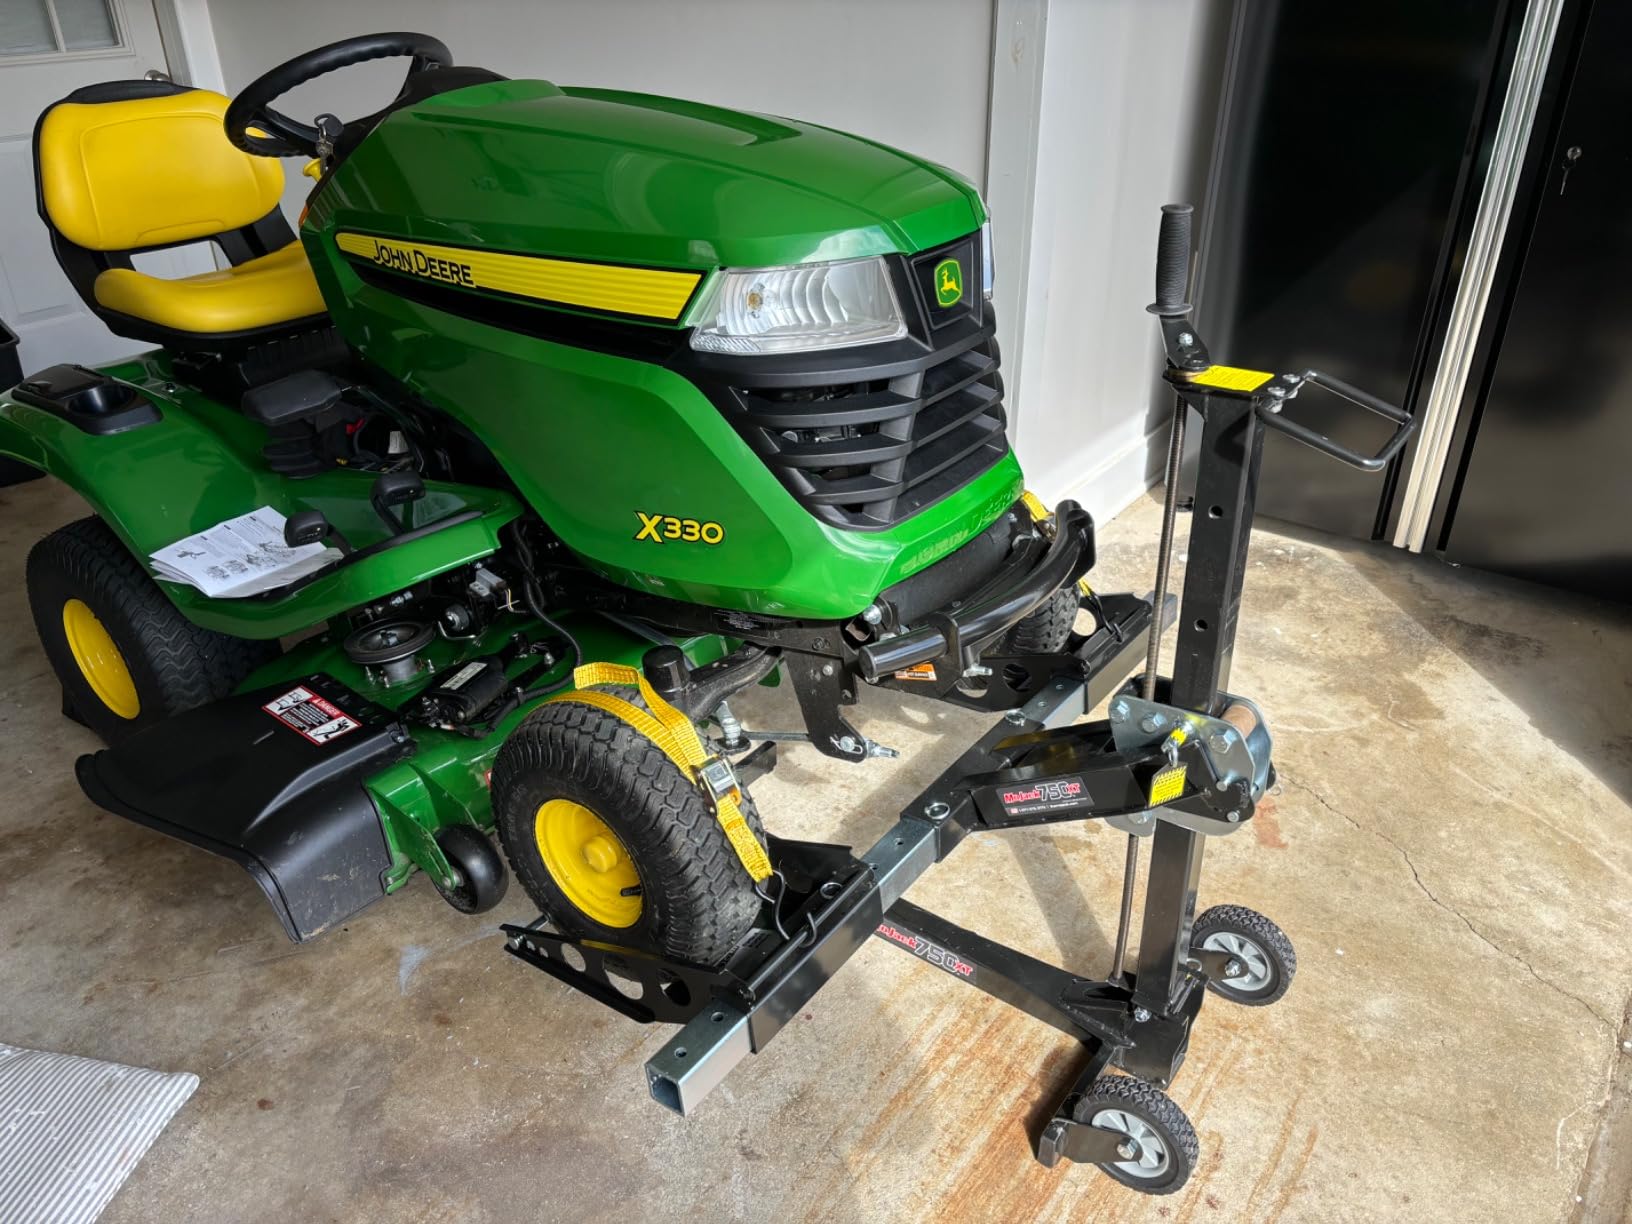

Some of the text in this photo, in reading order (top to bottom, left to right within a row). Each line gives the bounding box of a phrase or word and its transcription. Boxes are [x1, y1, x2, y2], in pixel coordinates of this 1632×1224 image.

[373, 240, 475, 286] JOHN DEERE
[633, 511, 725, 545] X330
